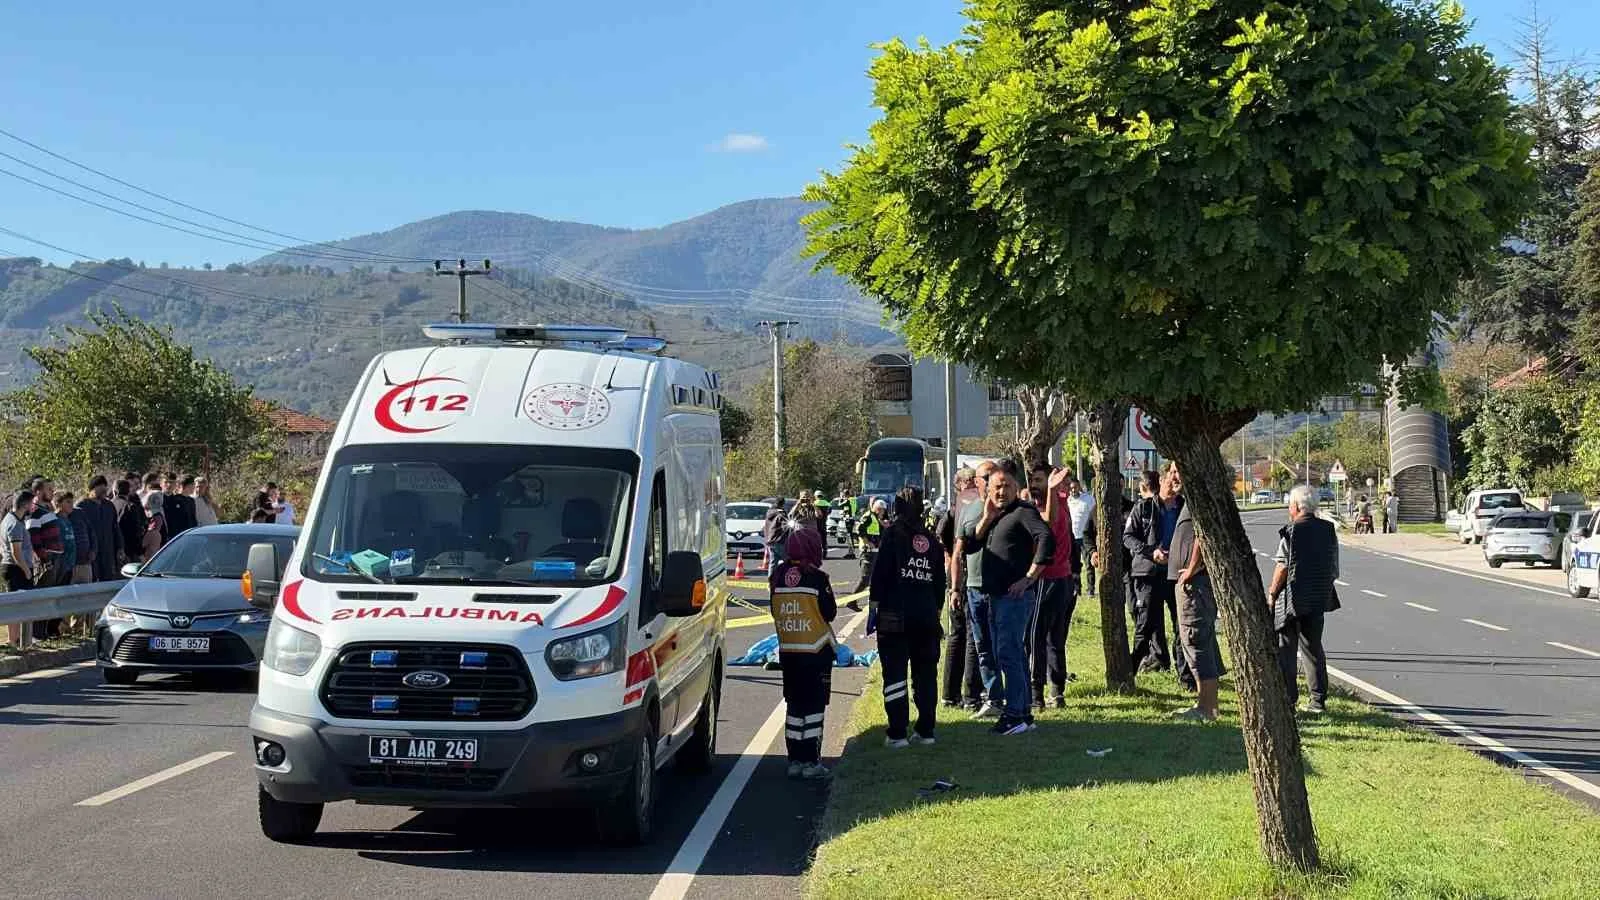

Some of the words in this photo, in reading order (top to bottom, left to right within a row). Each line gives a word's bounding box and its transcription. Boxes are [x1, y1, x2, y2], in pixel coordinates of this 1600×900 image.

[397, 394, 470, 413] 112
[155, 639, 166, 649] 06
[171, 639, 182, 649] DE
[379, 739, 398, 757] 81
[407, 739, 437, 758] AAR
[445, 740, 475, 759] 249
